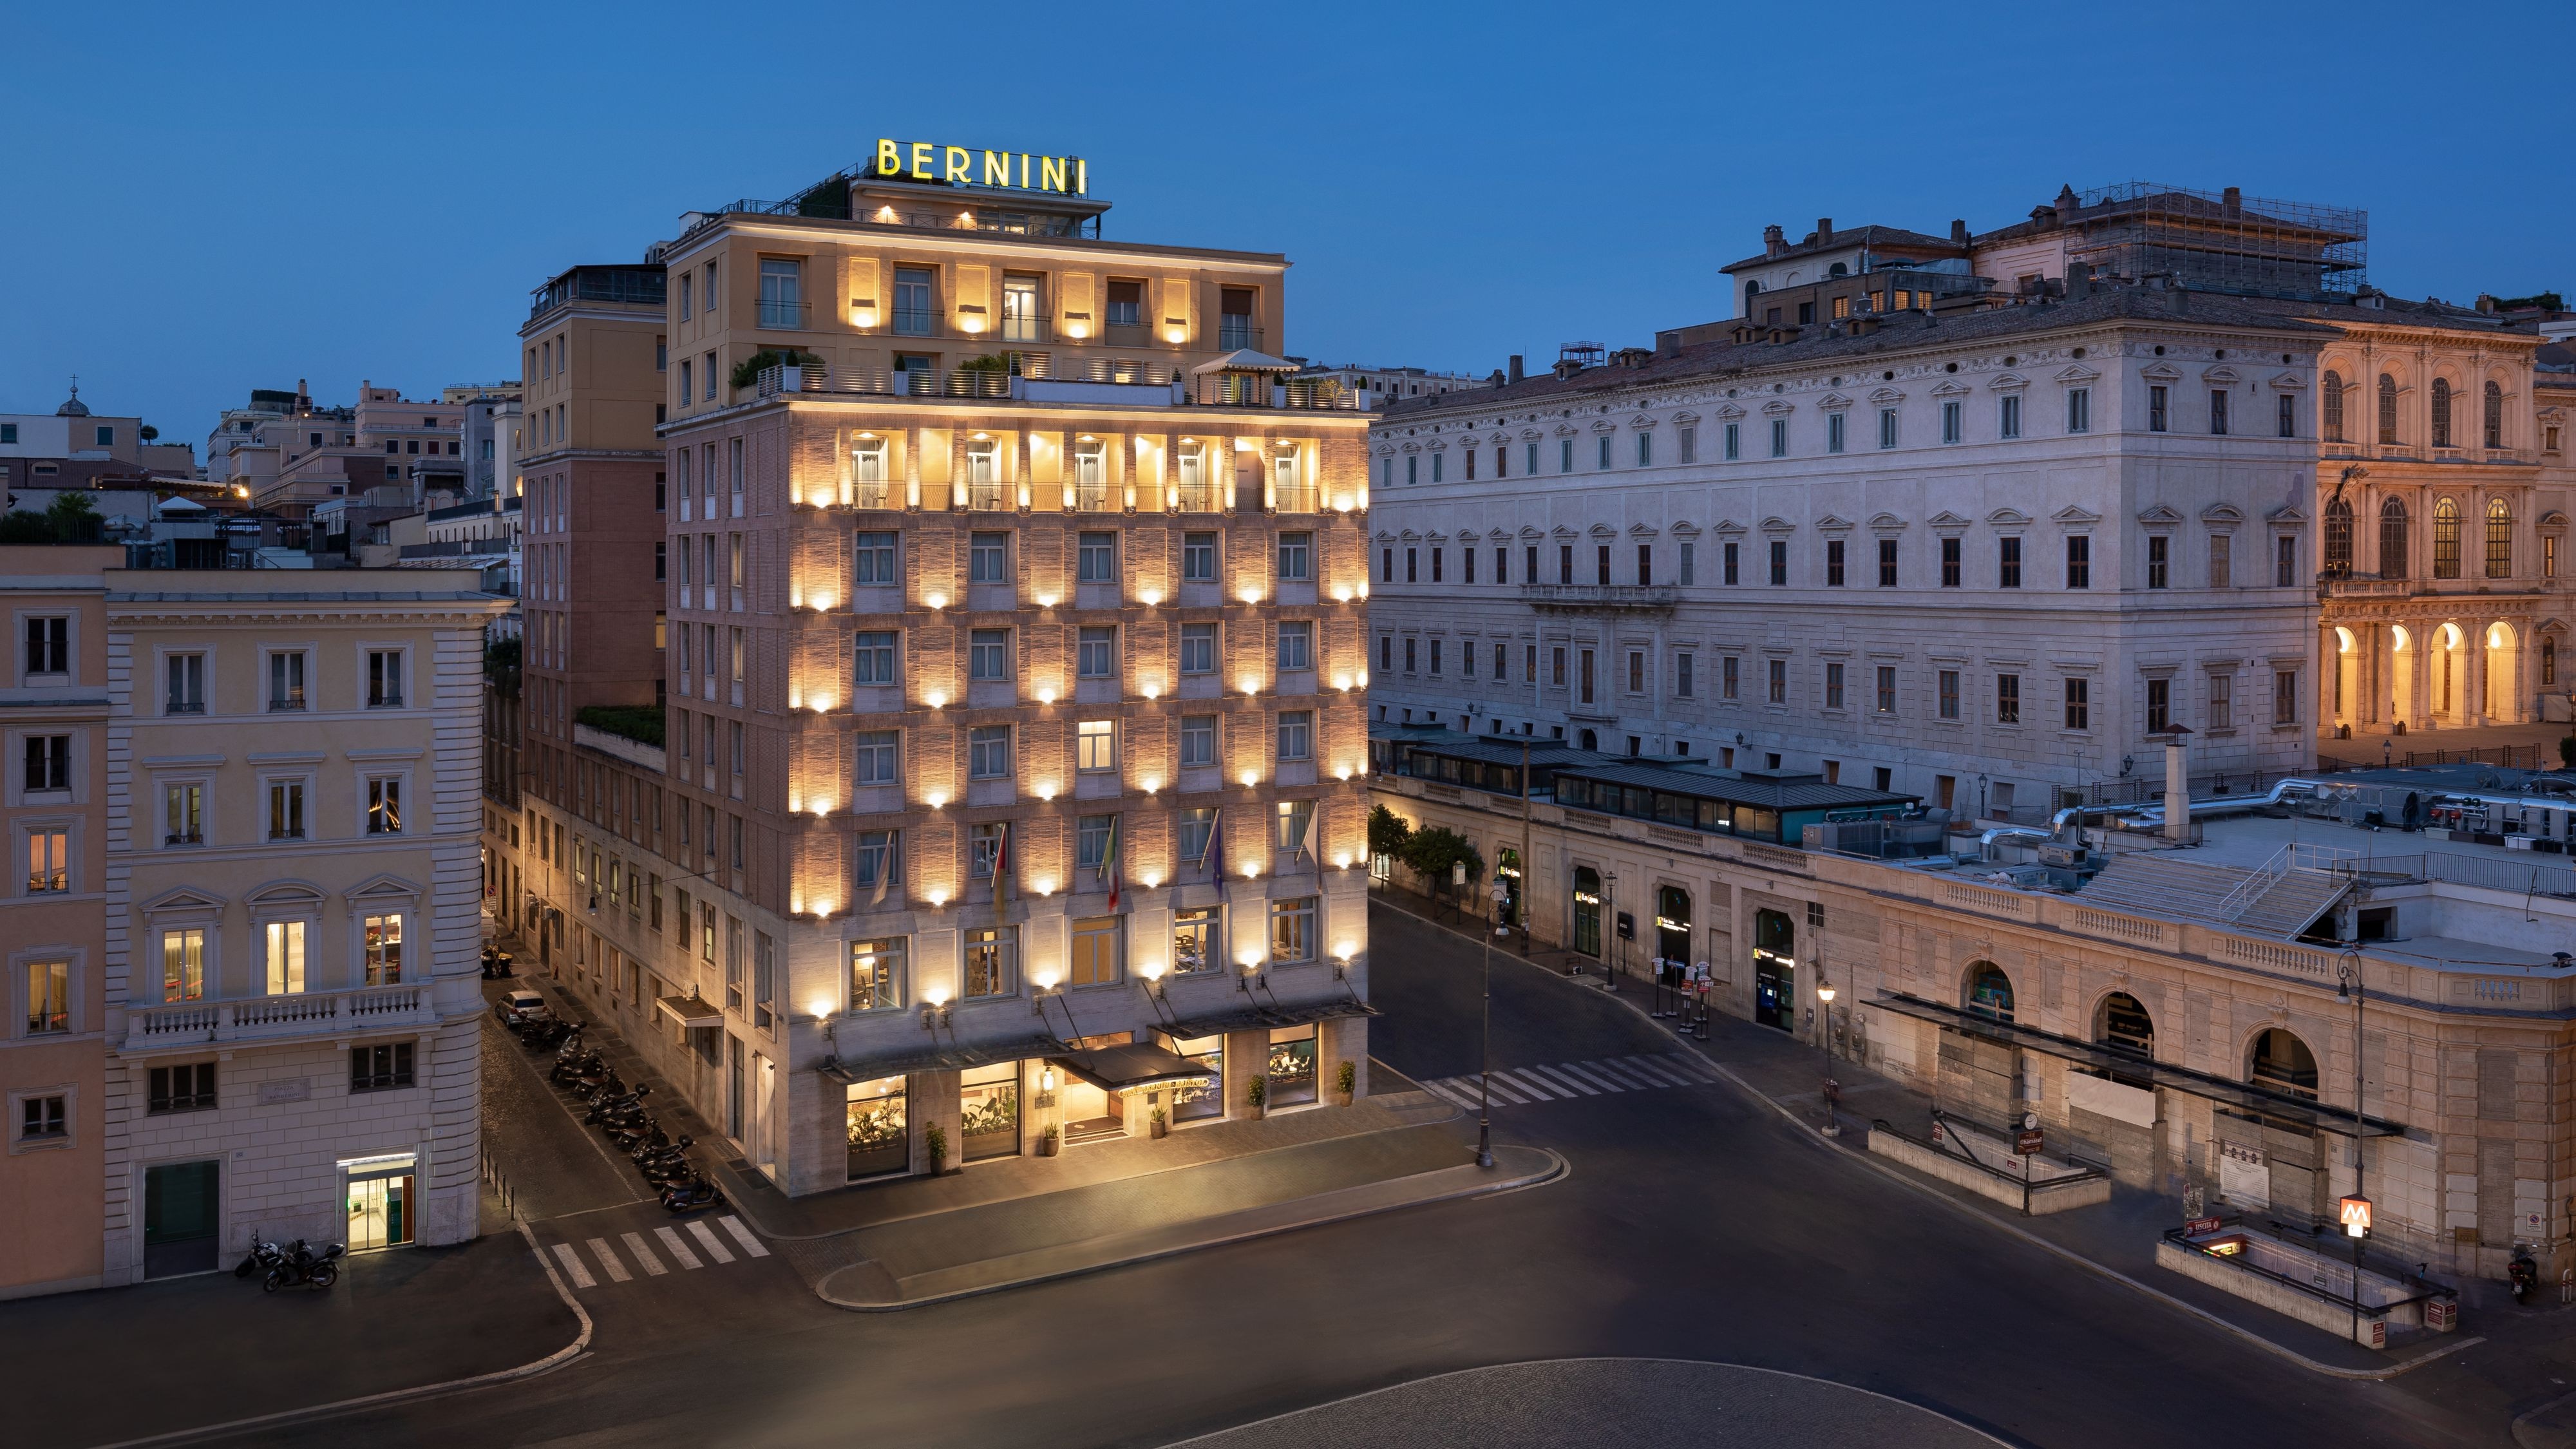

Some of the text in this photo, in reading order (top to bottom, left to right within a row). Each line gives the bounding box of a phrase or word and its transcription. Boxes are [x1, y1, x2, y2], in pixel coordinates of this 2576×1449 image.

[877, 138, 1086, 194] BERNINI
[2342, 1204, 2369, 1222] M
[2195, 1222, 2212, 1230] USCITA
